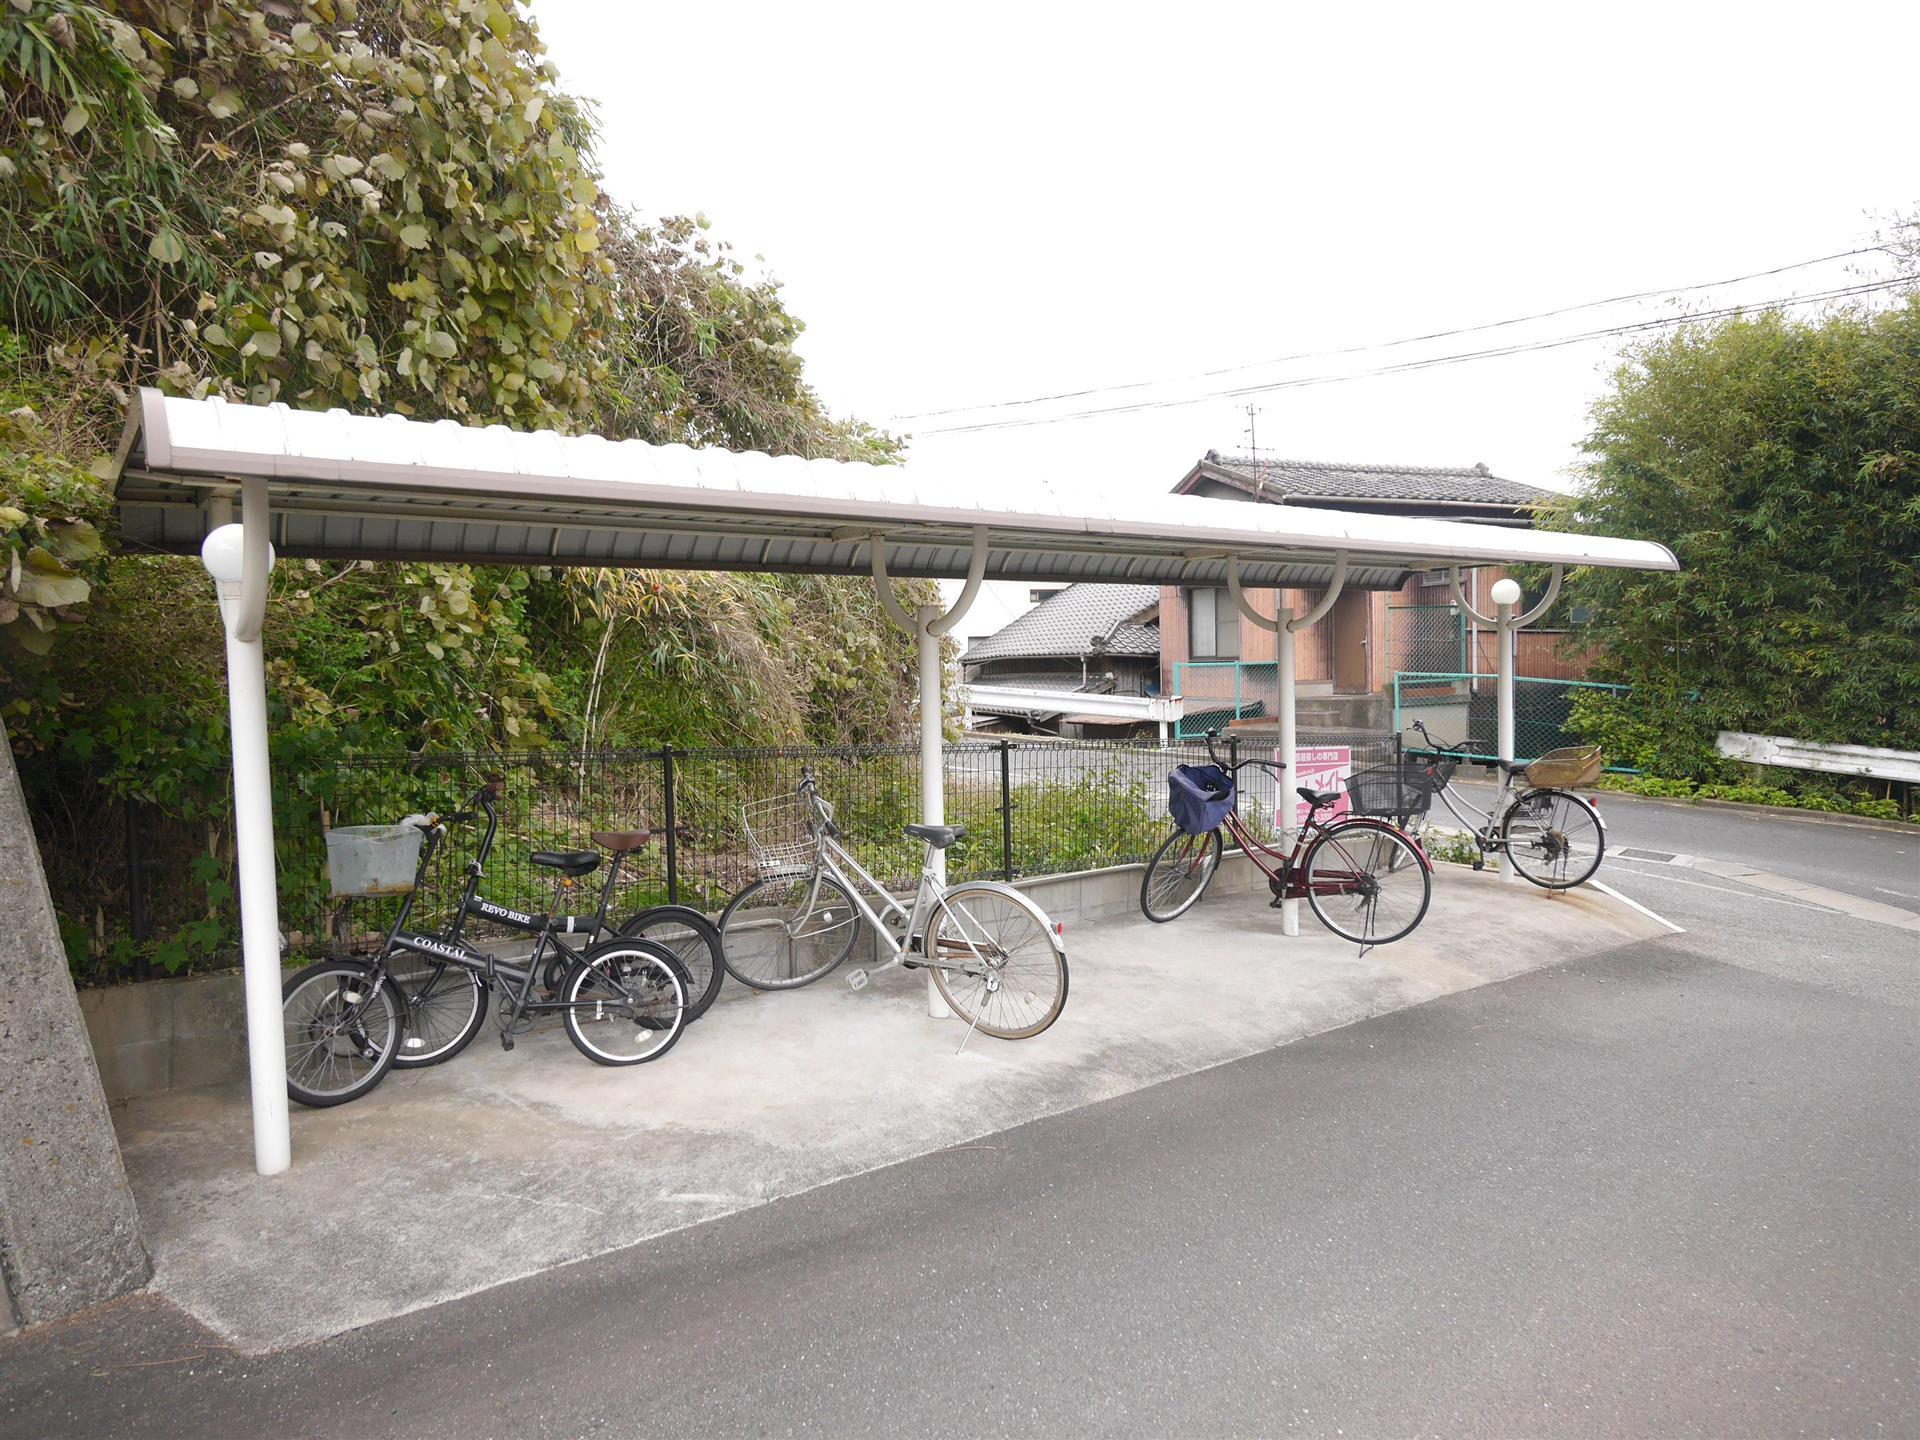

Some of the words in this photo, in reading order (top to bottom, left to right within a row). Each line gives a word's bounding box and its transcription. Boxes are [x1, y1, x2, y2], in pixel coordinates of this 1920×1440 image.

[481, 903, 507, 917] REVO
[508, 911, 531, 924] BIKE
[414, 936, 467, 960] COASTAL
